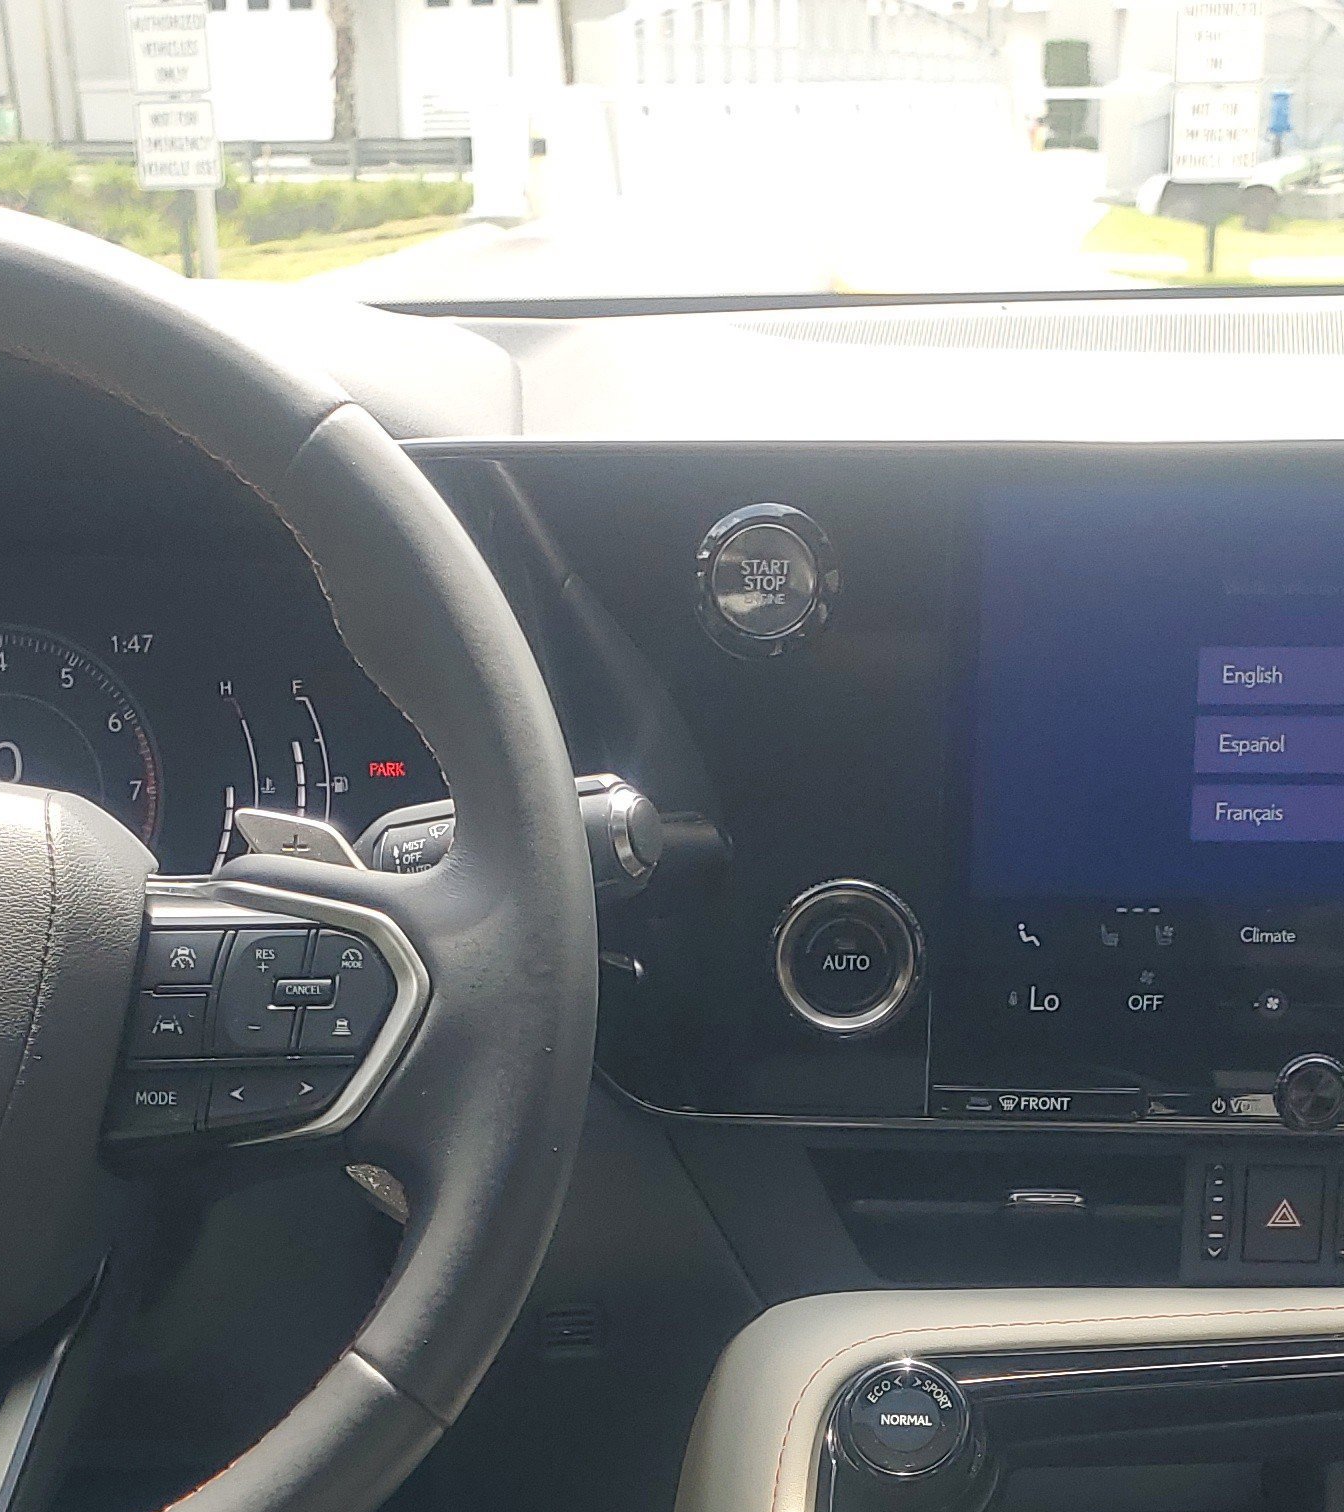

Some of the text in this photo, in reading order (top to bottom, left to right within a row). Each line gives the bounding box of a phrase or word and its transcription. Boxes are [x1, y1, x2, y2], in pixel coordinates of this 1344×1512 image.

[740, 559, 792, 576] START
[743, 576, 787, 592] STOP
[110, 634, 155, 654] 1:47
[61, 668, 74, 689] 5
[1221, 664, 1284, 690] English
[219, 681, 233, 697] H
[291, 679, 304, 696] F
[108, 713, 123, 733] 6
[1219, 732, 1286, 757] Español
[368, 760, 406, 778] PARK
[129, 781, 143, 801] 7
[1214, 801, 1285, 827] Français
[402, 838, 427, 853] MIST
[402, 852, 423, 865] OFF
[1239, 925, 1297, 946] Climate
[254, 948, 276, 961] RES
[822, 955, 871, 971] AUTO
[340, 961, 364, 970] MODE
[285, 984, 324, 996] CANCEL
[1030, 986, 1061, 1014] Lo
[1127, 994, 1165, 1013] OFF
[136, 1090, 179, 1106] MODE
[1020, 1096, 1072, 1111] FRONT
[867, 1380, 892, 1404] ECO
[922, 1379, 954, 1411] SPORT
[880, 1413, 933, 1427] NORMAL
